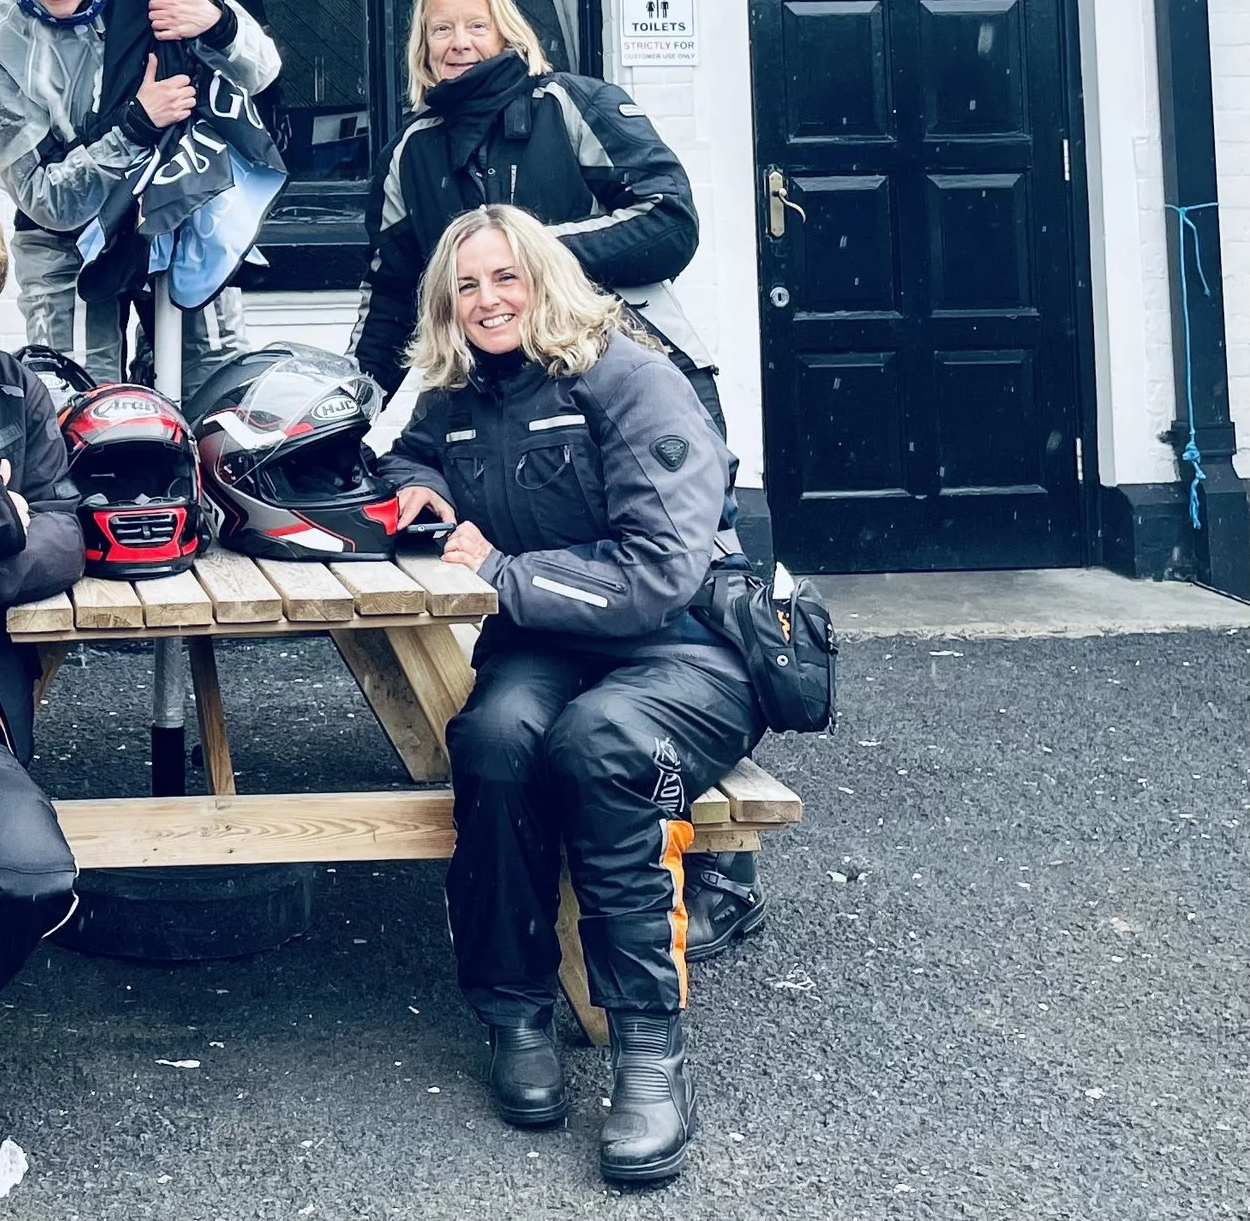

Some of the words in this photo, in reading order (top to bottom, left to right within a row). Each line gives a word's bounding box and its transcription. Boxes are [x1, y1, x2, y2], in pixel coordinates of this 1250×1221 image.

[631, 22, 686, 32] TOILETS
[624, 41, 672, 50] STRICTLY
[674, 41, 695, 50] FOR
[321, 399, 355, 416] HJC
